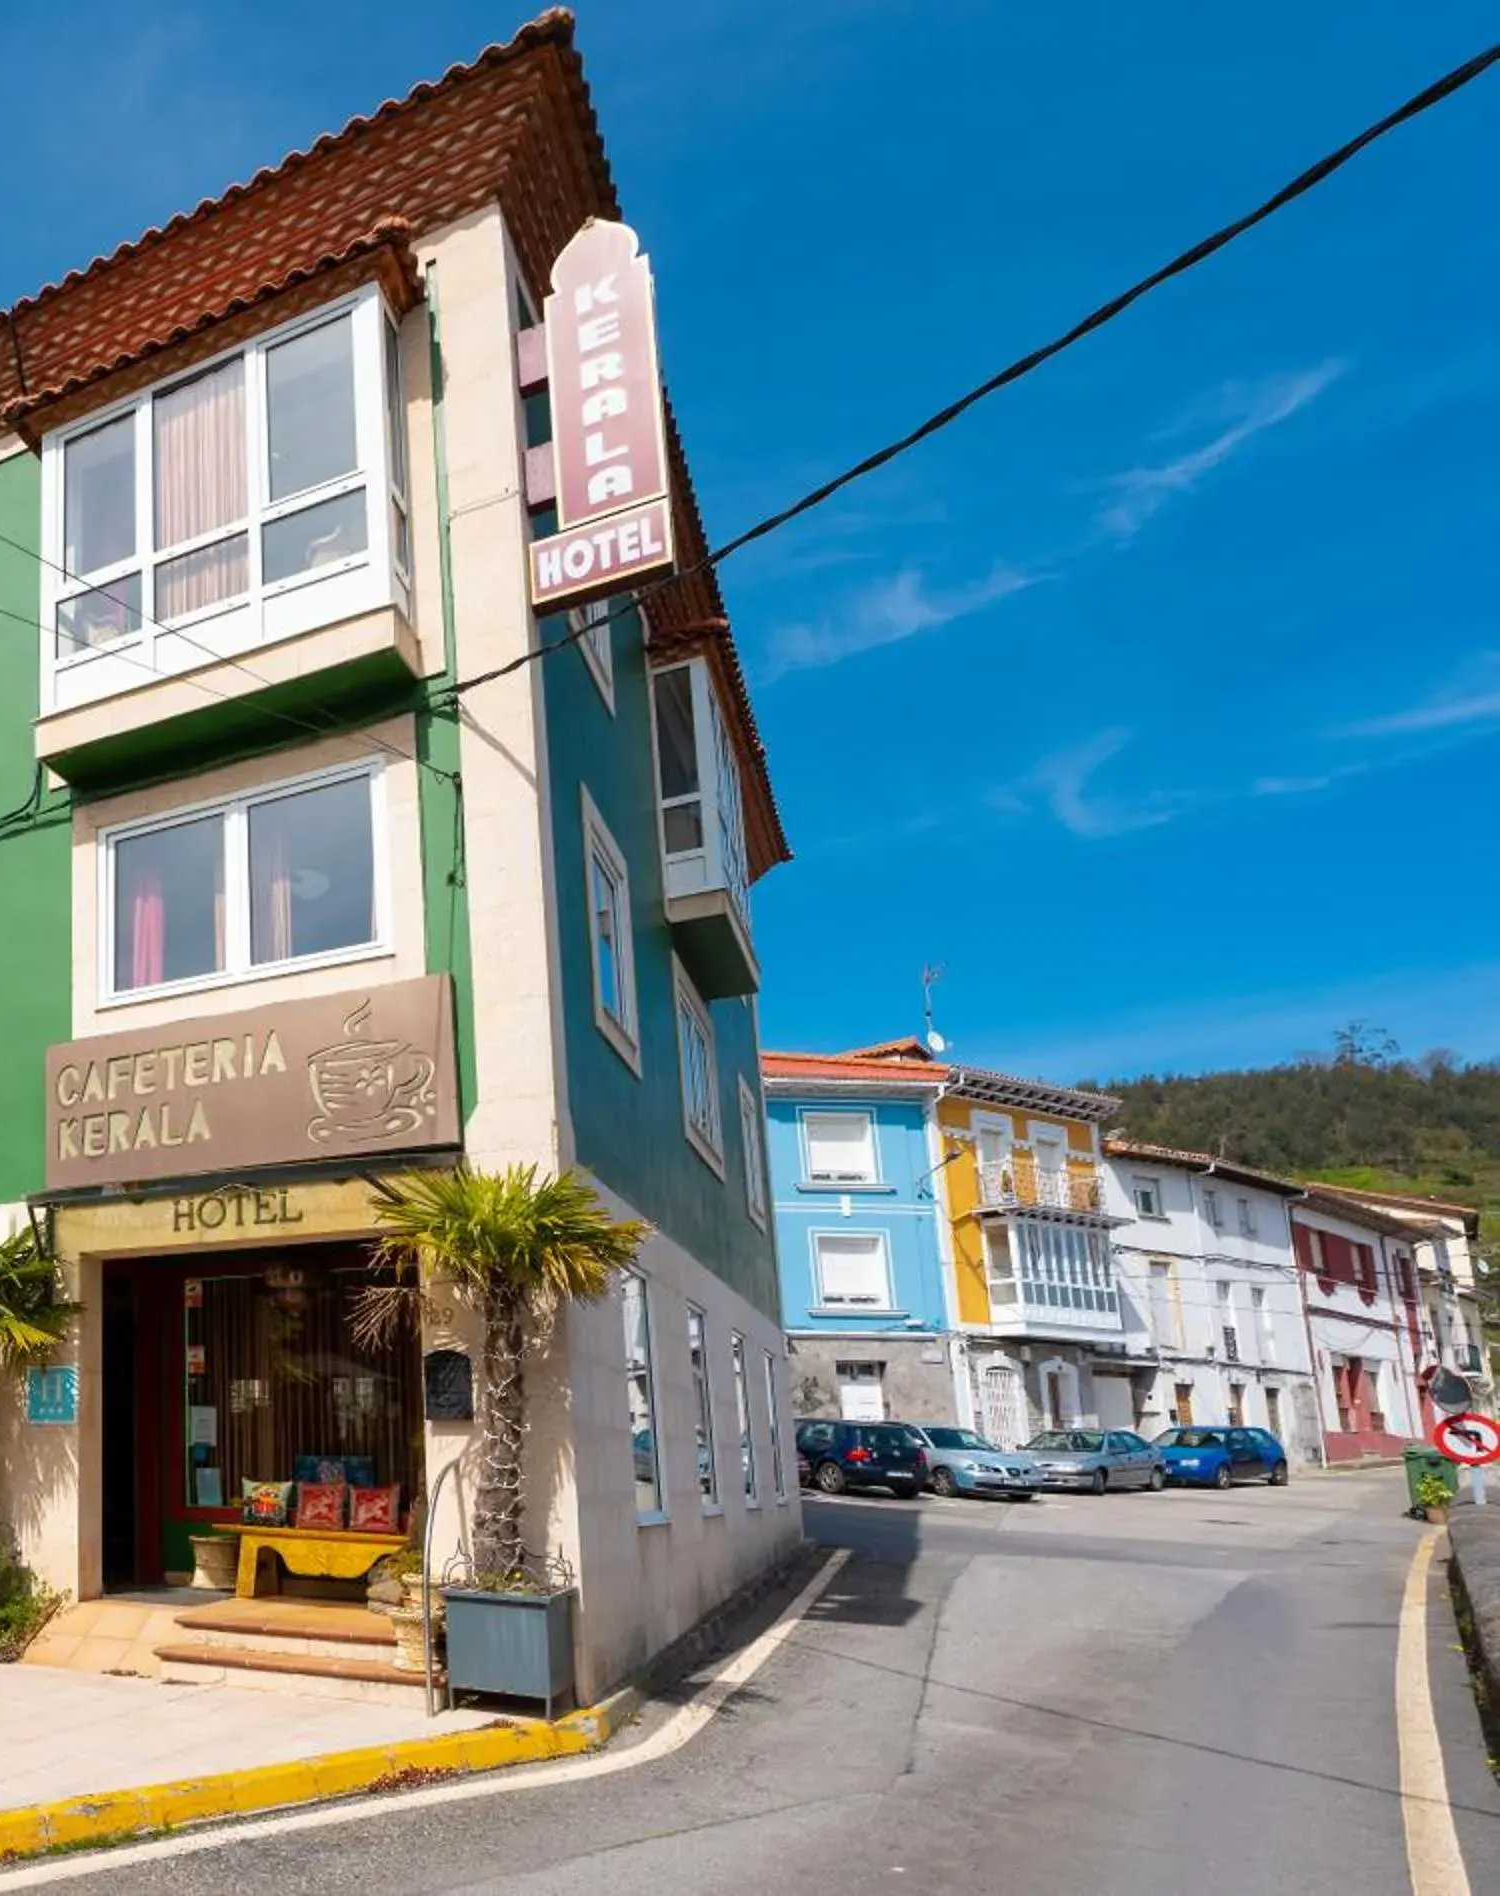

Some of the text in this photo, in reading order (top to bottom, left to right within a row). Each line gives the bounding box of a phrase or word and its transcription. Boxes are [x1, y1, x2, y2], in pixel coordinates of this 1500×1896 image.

[574, 272, 633, 506] KERALA
[536, 519, 663, 590] HOTEL
[56, 1030, 288, 1108] CAFETERIA
[57, 1097, 213, 1162] KERALA
[173, 1188, 303, 1233] HOTEL
